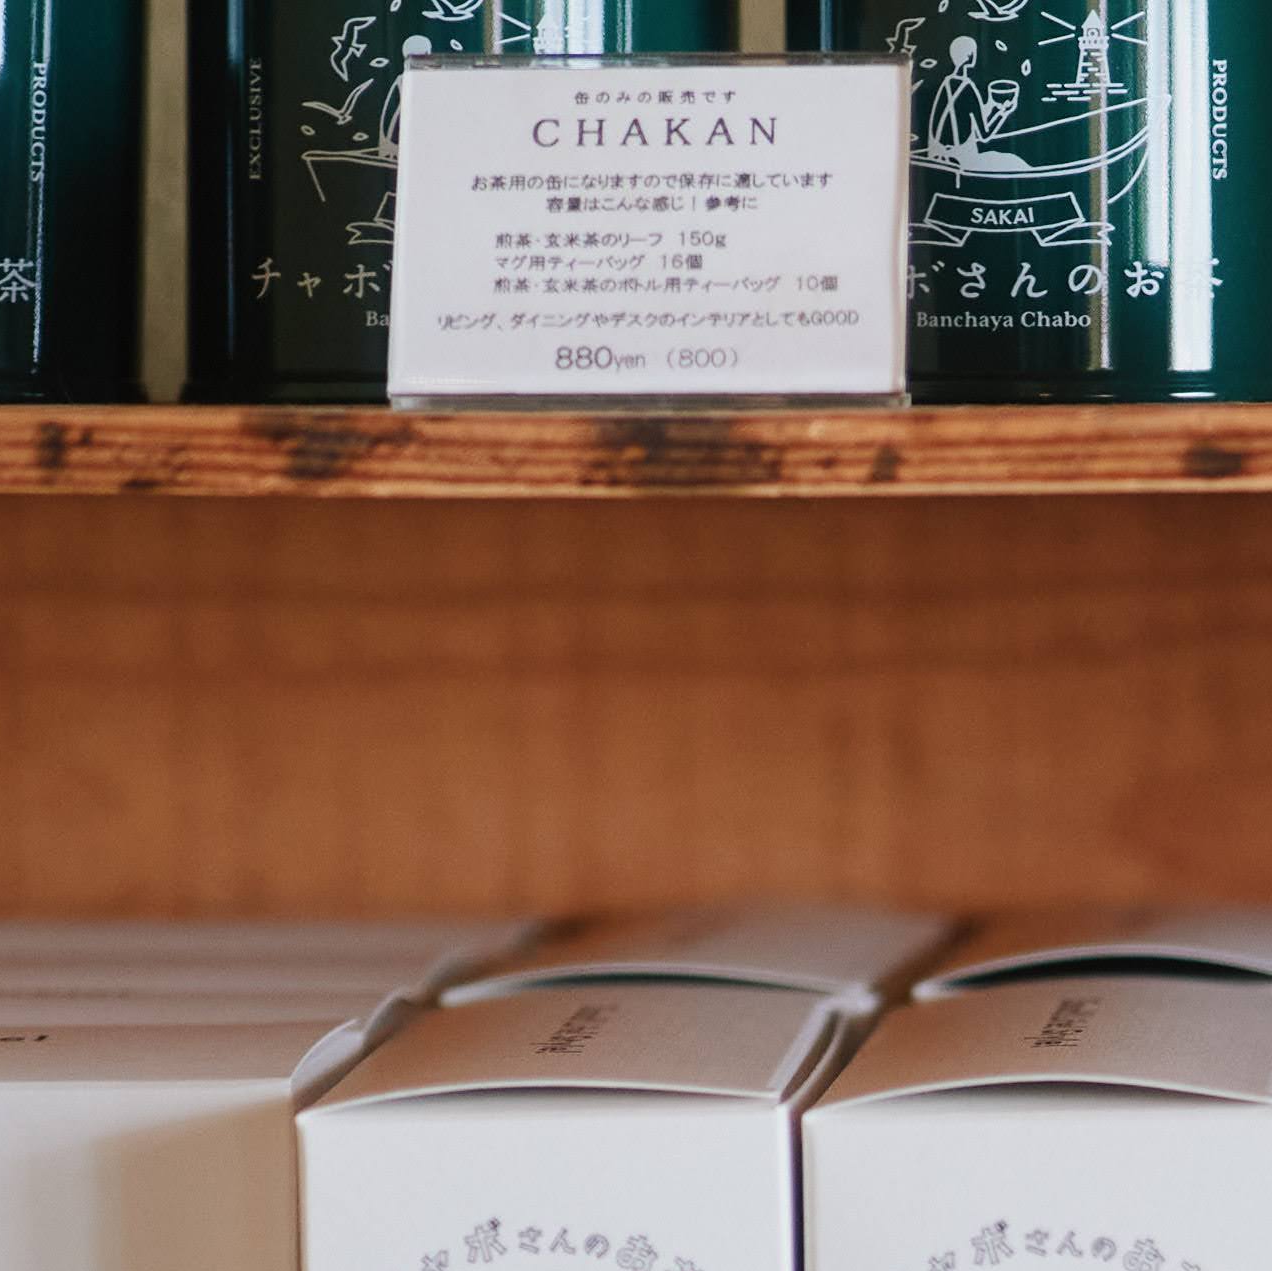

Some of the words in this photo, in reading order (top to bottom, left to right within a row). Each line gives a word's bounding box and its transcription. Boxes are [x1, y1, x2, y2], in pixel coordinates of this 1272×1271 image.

[31, 61, 46, 183] PRODUCTS
[248, 56, 263, 181] EXCLUSIVE
[1213, 59, 1227, 180] PRODUCTS
[532, 117, 777, 148] CHAKAN
[969, 206, 1036, 227] SAKAI
[680, 230, 727, 249] 150g
[662, 253, 703, 270] 16個
[797, 275, 839, 292] 10個
[916, 311, 1014, 332] Banchaya
[1019, 308, 1092, 329] Chabo
[554, 345, 646, 370] 880yen
